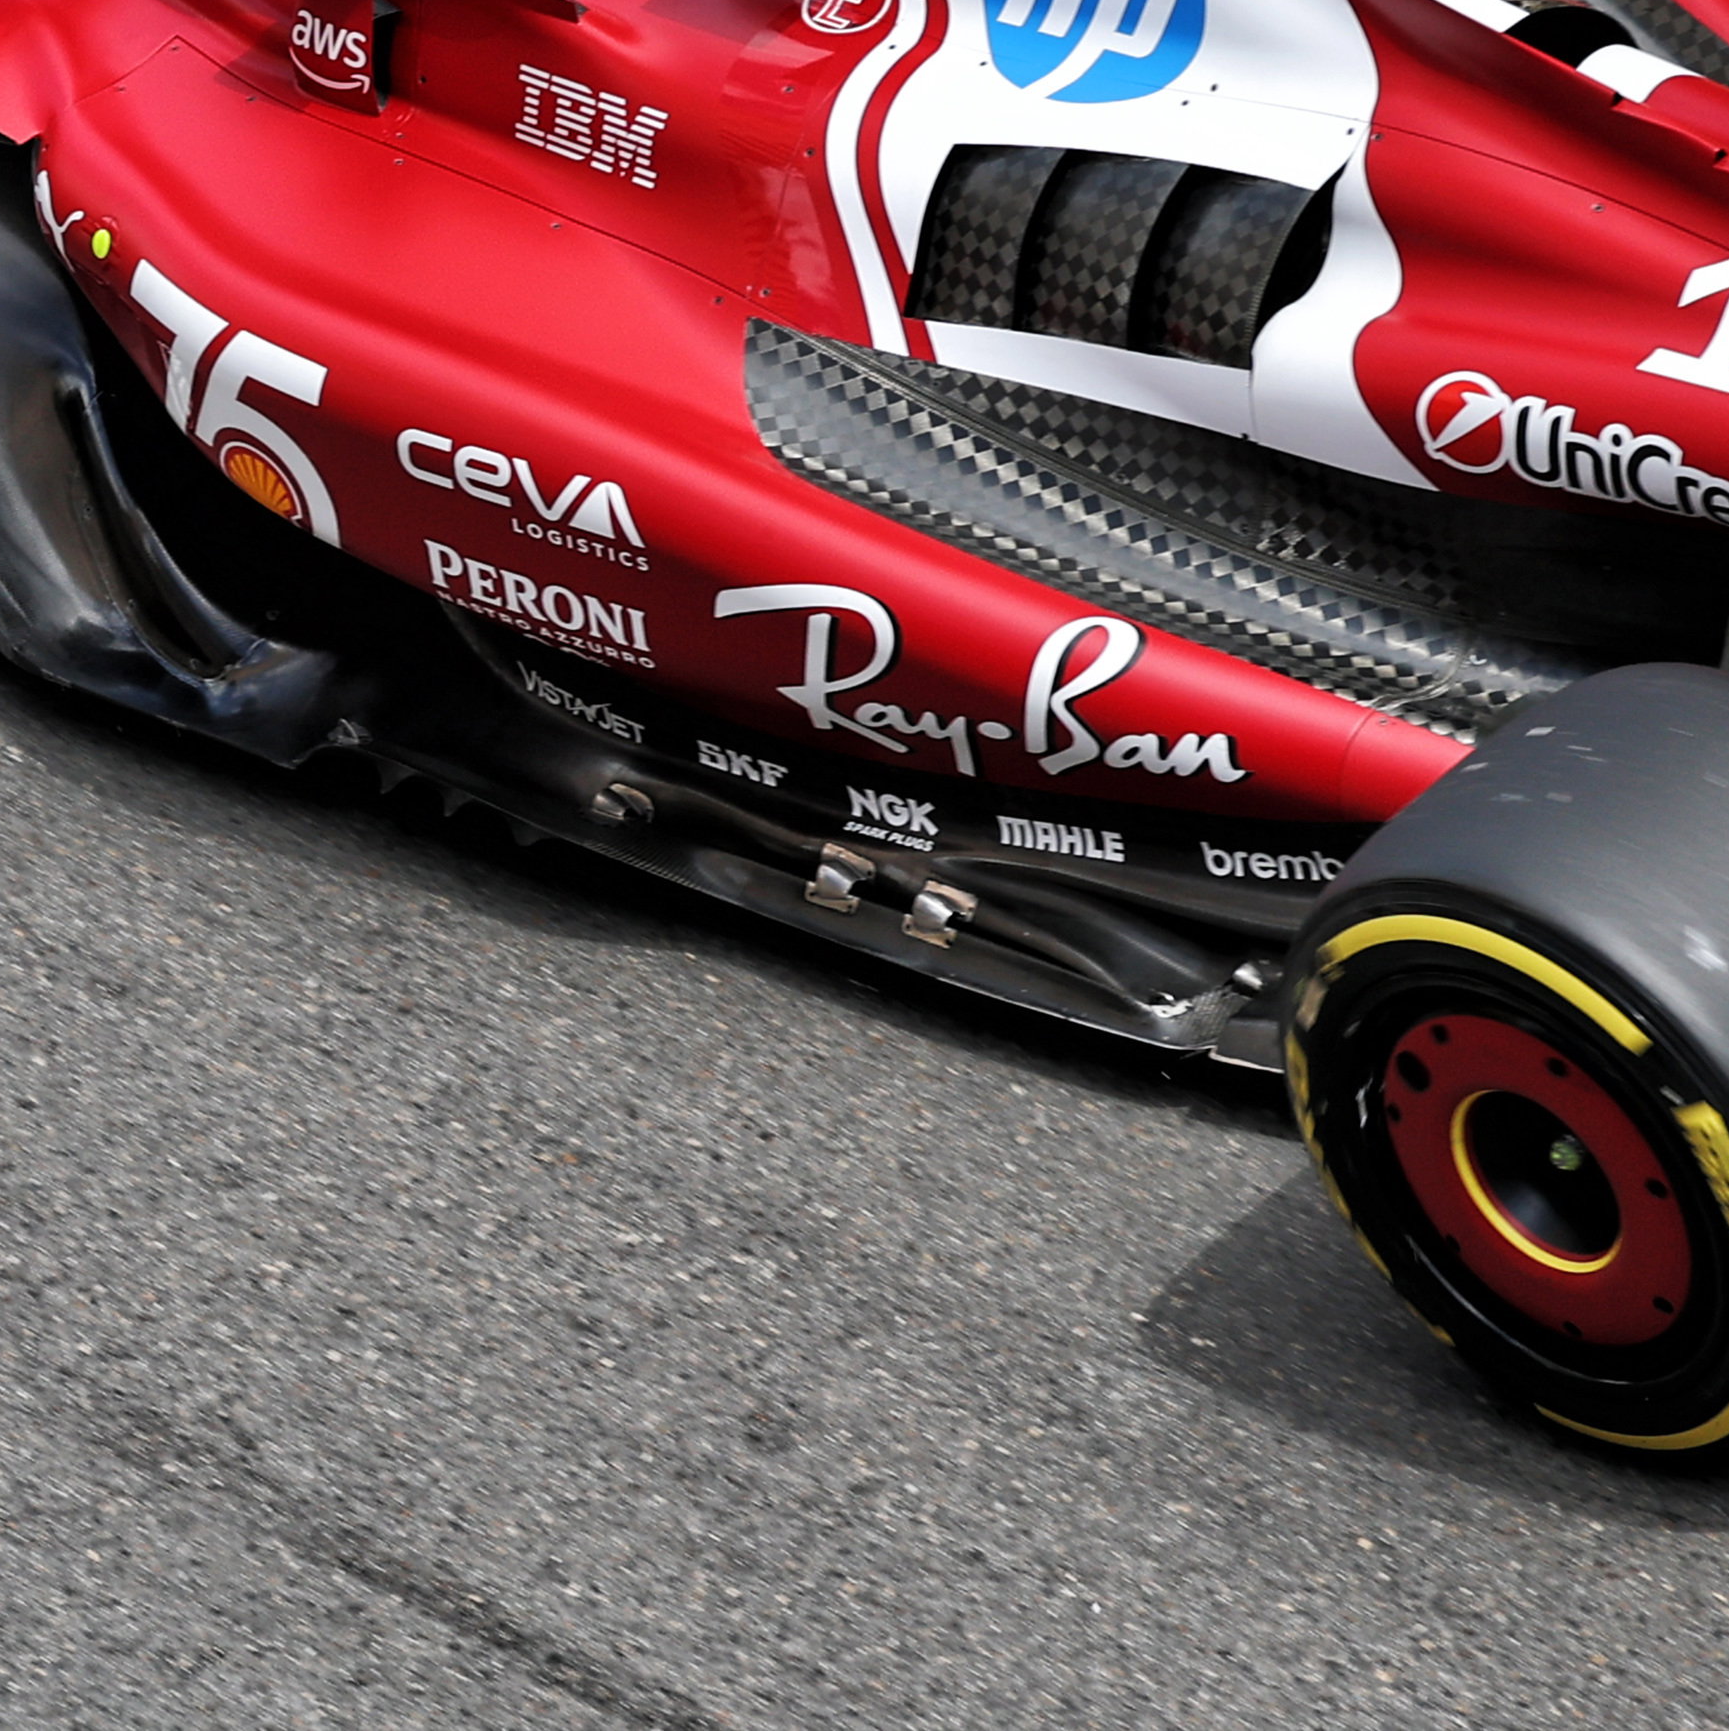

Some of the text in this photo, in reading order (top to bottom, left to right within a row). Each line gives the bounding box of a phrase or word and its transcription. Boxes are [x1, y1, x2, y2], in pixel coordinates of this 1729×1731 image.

[292, 9, 368, 69] aws
[514, 63, 668, 189] IBM
[511, 518, 650, 571] LOGISTICS
[423, 538, 652, 653] PERONI
[539, 626, 656, 669] AZZURRO
[696, 739, 789, 788] SKF
[843, 820, 935, 853] SPARK PLUGS
[845, 785, 940, 845] NGK
[996, 814, 1125, 863] MAHLE
[1199, 841, 1344, 882] bremb
